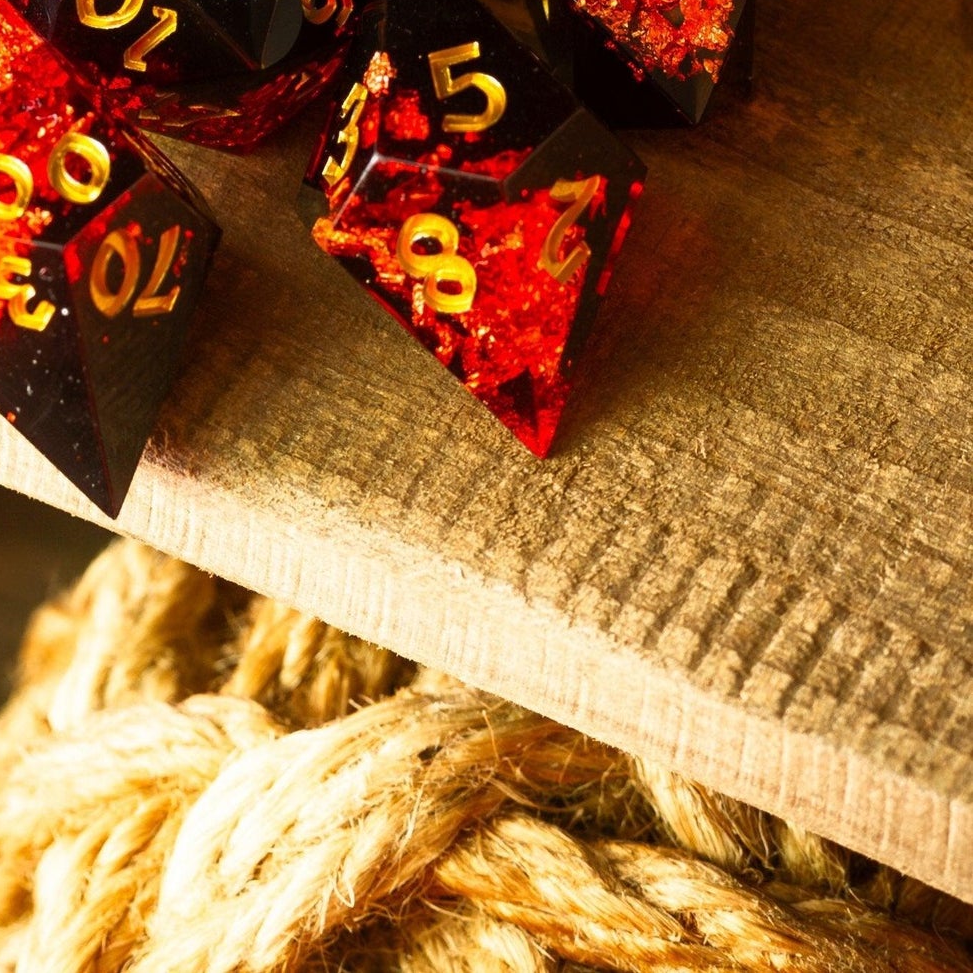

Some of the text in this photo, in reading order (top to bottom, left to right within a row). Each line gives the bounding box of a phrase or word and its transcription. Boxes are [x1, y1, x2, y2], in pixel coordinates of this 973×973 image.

[321, 81, 369, 186] 3
[428, 40, 508, 133] 5
[88, 224, 182, 319] 70
[395, 211, 479, 314] 8
